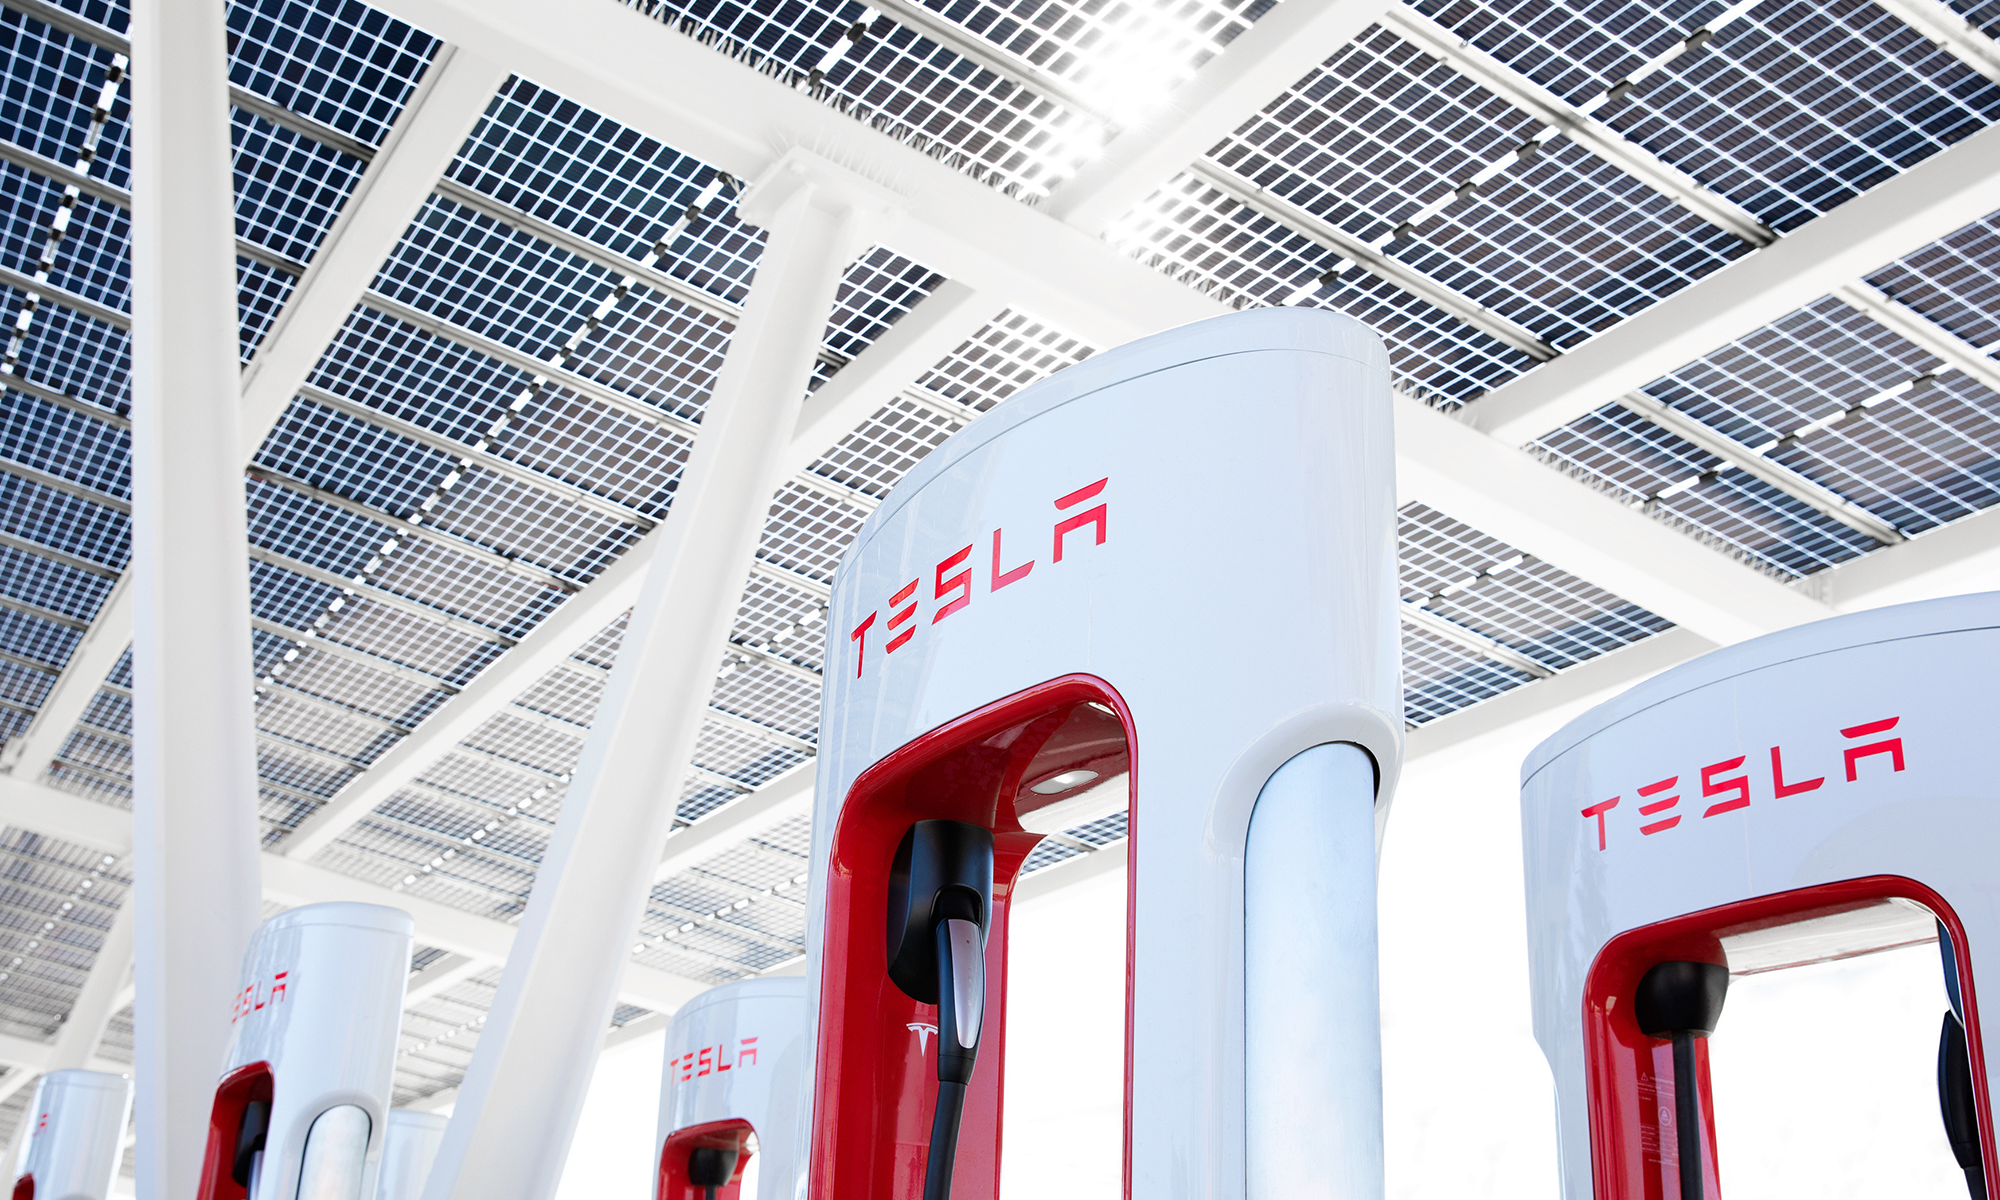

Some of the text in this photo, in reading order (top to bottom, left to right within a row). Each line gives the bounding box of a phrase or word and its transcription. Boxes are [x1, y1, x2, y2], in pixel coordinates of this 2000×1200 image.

[851, 477, 1109, 679] TESLA
[1581, 716, 1905, 851] TESLA
[231, 971, 289, 1024] ESLA
[670, 1037, 758, 1085] TESLA
